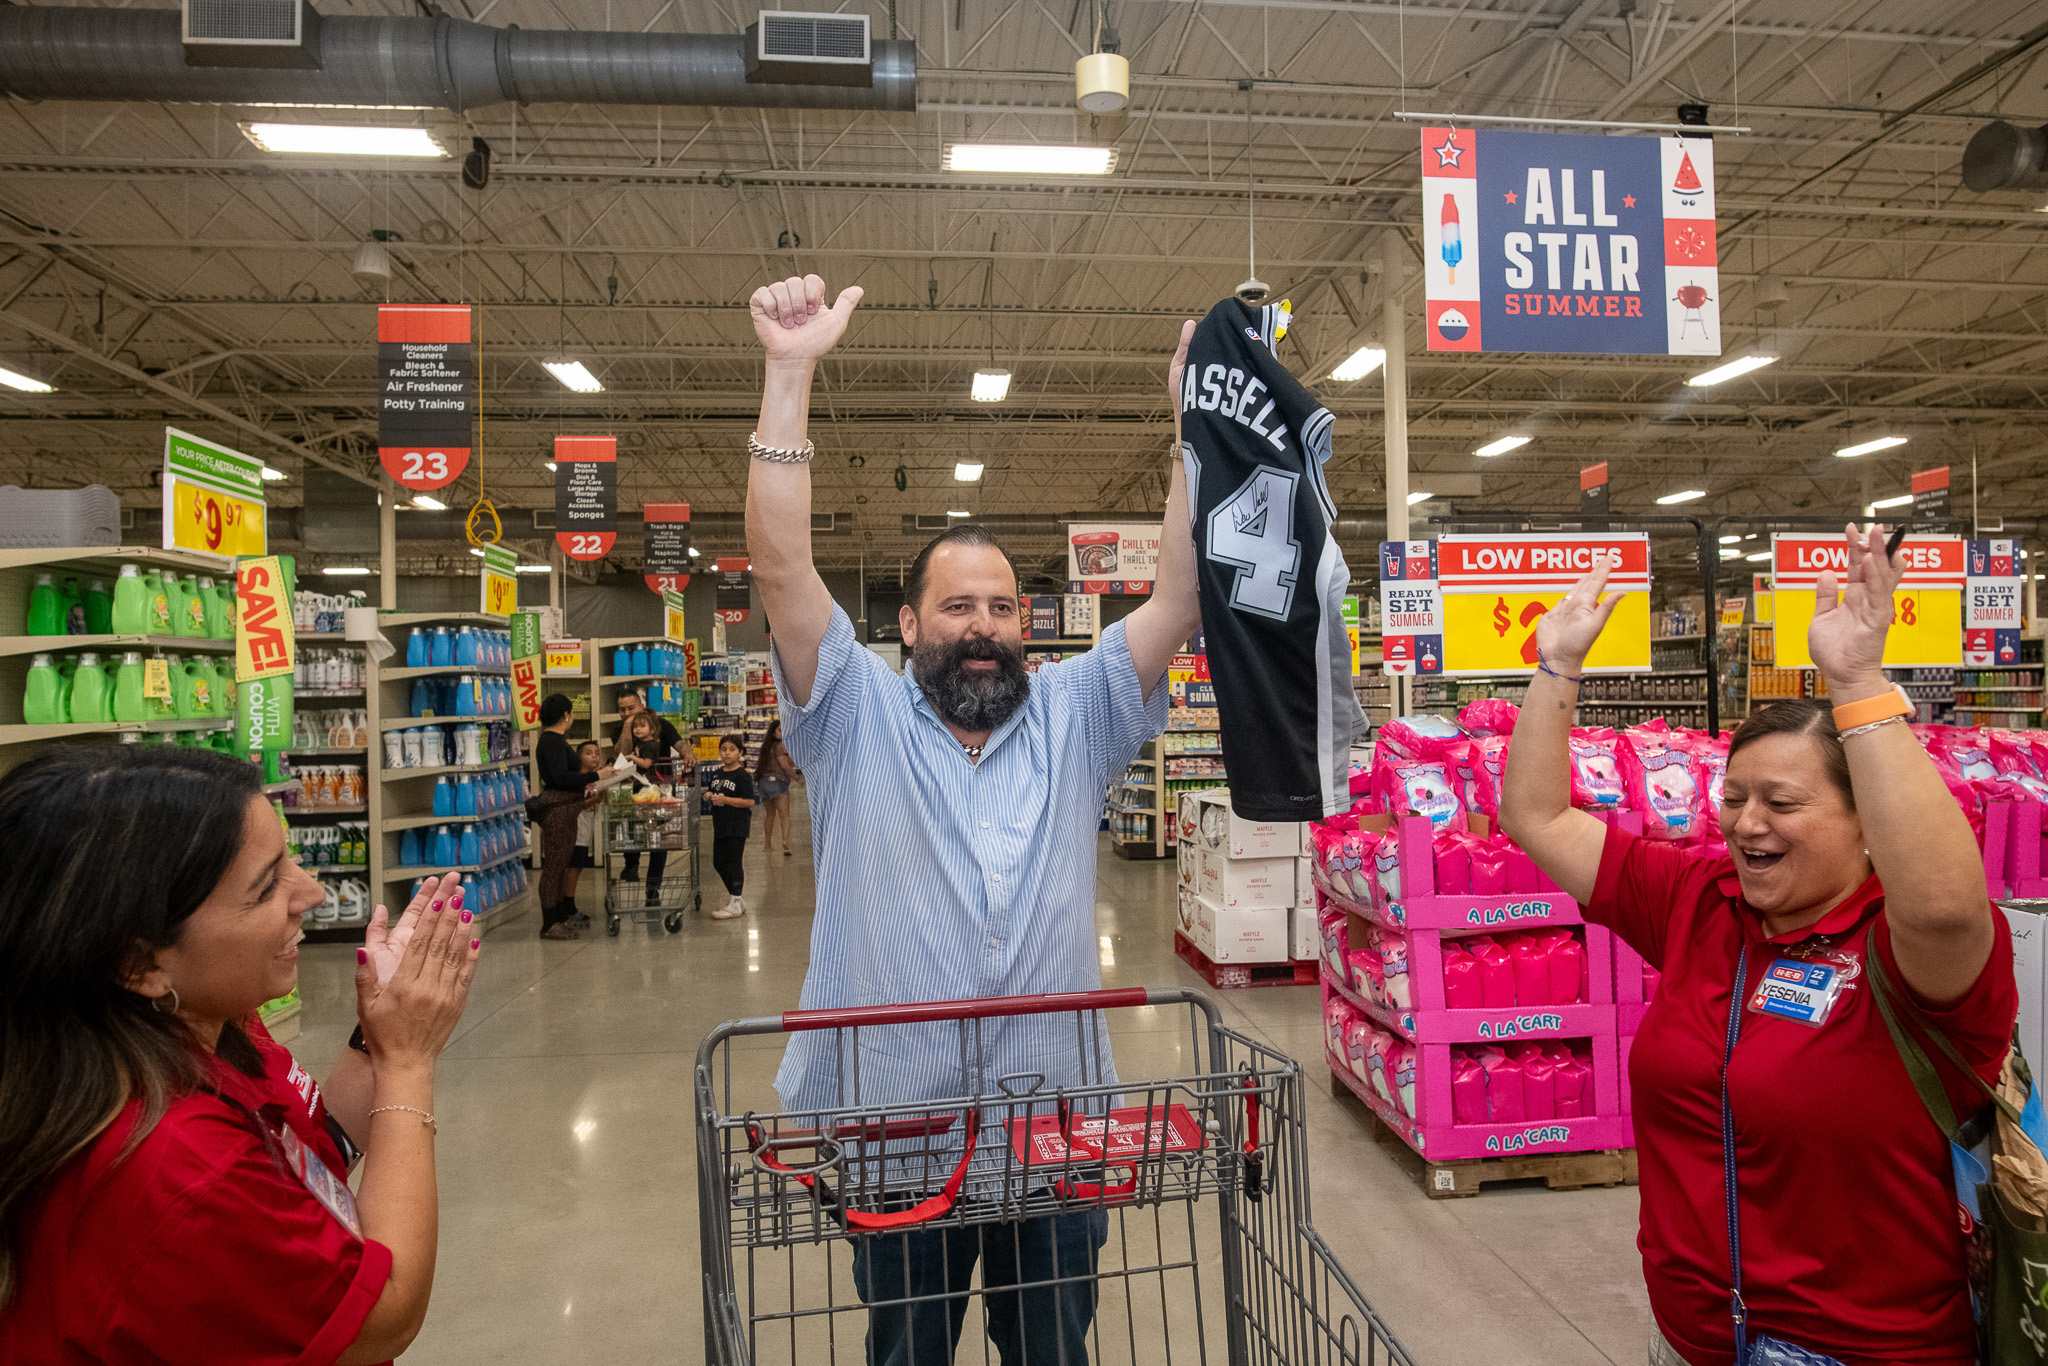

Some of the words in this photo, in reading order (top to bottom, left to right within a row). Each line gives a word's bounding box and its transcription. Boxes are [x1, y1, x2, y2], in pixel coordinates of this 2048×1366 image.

[1524, 167, 1618, 227] ALL
[1504, 231, 1641, 291] STAR
[1505, 293, 1643, 317] SUMMER
[402, 344, 448, 352] Household
[390, 369, 418, 377] Fabric
[421, 369, 460, 377] Softener
[405, 362, 436, 370] Bleach
[438, 362, 445, 370] &
[386, 381, 404, 392] Air
[406, 381, 463, 392] Freshener
[384, 399, 415, 411] Potty
[418, 399, 465, 411] Training
[1180, 363, 1288, 452] ASSELL
[175, 444, 195, 461] YOUR
[195, 452, 214, 466] PRICE
[402, 452, 449, 480] 23
[568, 511, 604, 519] Sponges
[571, 535, 602, 554] 22
[1122, 540, 1144, 549] CHILL
[1123, 556, 1145, 564] THRILL
[1462, 549, 1524, 570] LOW
[1531, 548, 1623, 570] PRICES
[1798, 548, 1849, 569] LOW
[658, 577, 677, 592] 21
[1388, 590, 1432, 598] READY
[1389, 599, 1433, 612] SET
[1974, 595, 2014, 607] SET
[237, 566, 289, 672] SAVE!
[726, 611, 742, 622] 20
[1033, 608, 1055, 616] SUMMER
[1390, 613, 1433, 627] SUMMER
[1974, 608, 2014, 620] SUMMER
[1033, 620, 1055, 629] SIZZLE
[684, 643, 698, 687] SAVE!
[514, 660, 542, 725] SAVE!
[1804, 670, 1814, 698] CUT
[249, 682, 263, 749] COUPON
[266, 697, 280, 736] WITH
[1467, 908, 1481, 924] A
[1484, 908, 1506, 925] LA
[1505, 901, 1552, 919] 'CART
[1776, 968, 1802, 980] H-E-B
[1810, 969, 1825, 979] 22
[1761, 983, 1811, 1006] YESENIA
[1478, 1021, 1492, 1038] A
[1496, 1020, 1517, 1038] LA
[1516, 1013, 1562, 1032] 'CART
[1486, 1135, 1500, 1151] A
[1503, 1134, 1525, 1151] LA
[1524, 1126, 1570, 1145] 'CART
